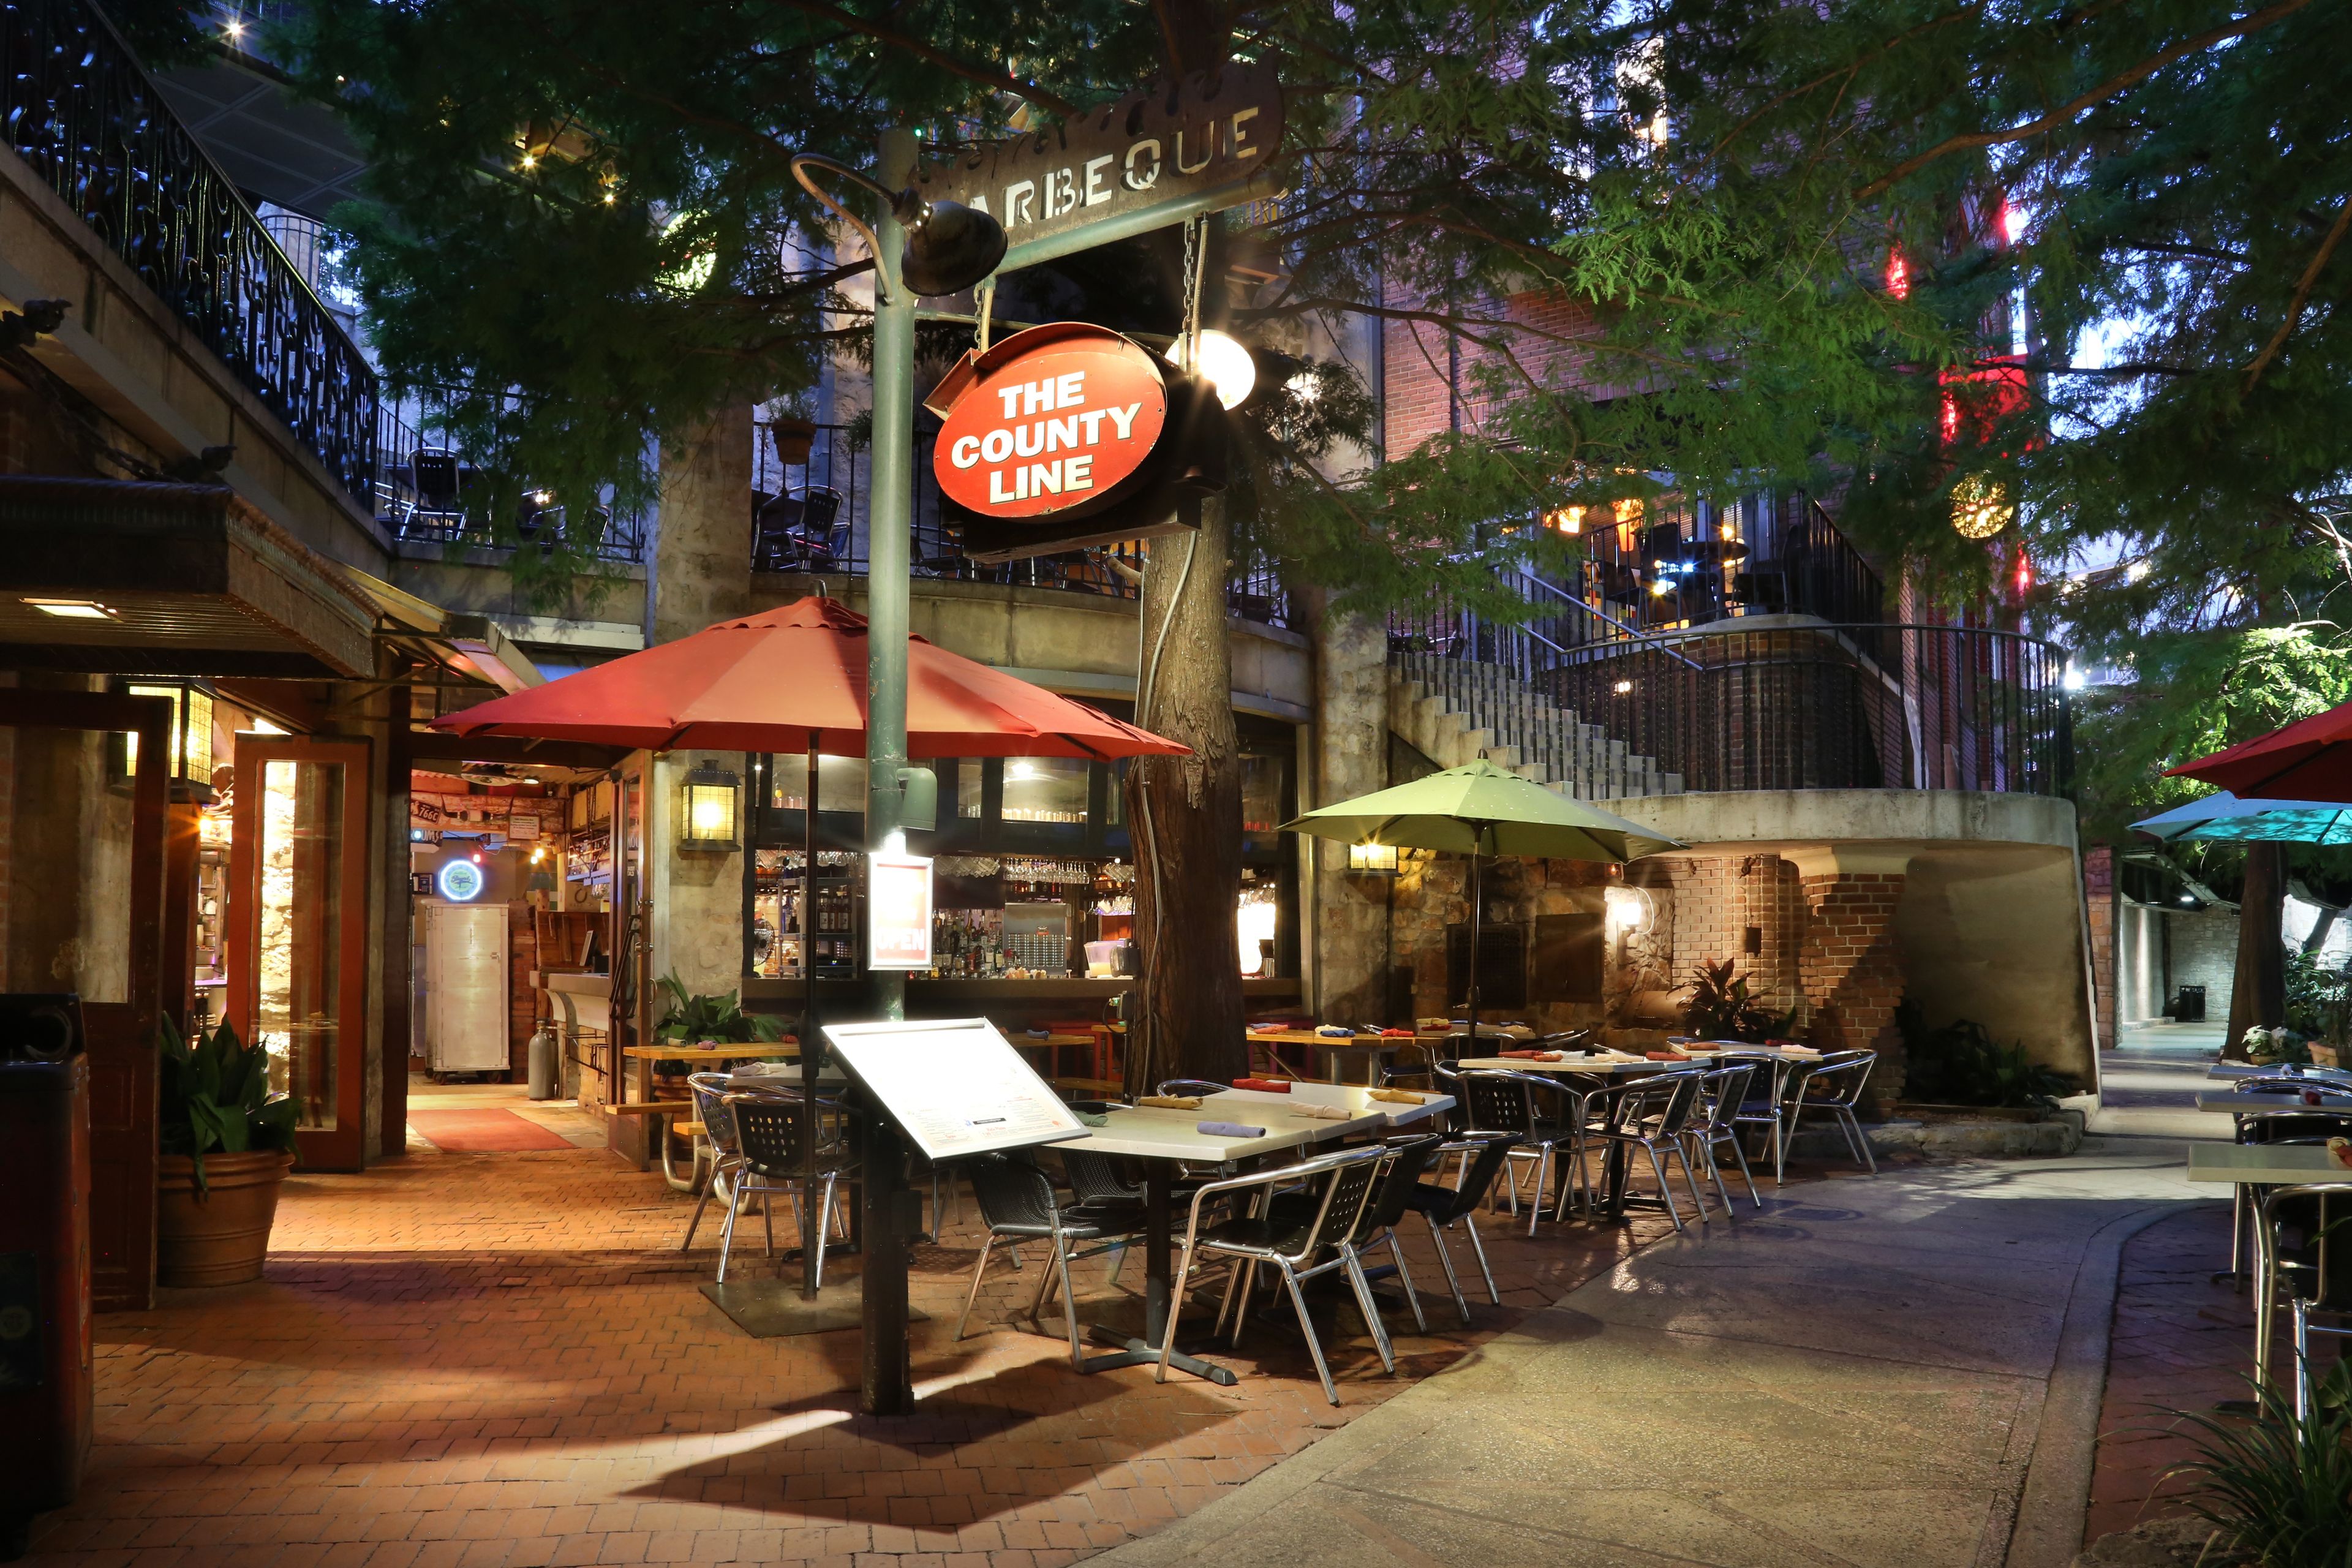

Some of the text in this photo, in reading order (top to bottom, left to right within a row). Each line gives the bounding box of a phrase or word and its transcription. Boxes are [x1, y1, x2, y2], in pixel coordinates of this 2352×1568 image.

[998, 371, 1085, 420] THE
[951, 402, 1142, 469] COUNTY
[989, 455, 1094, 504] LINE
[877, 929, 925, 951] OPEN
